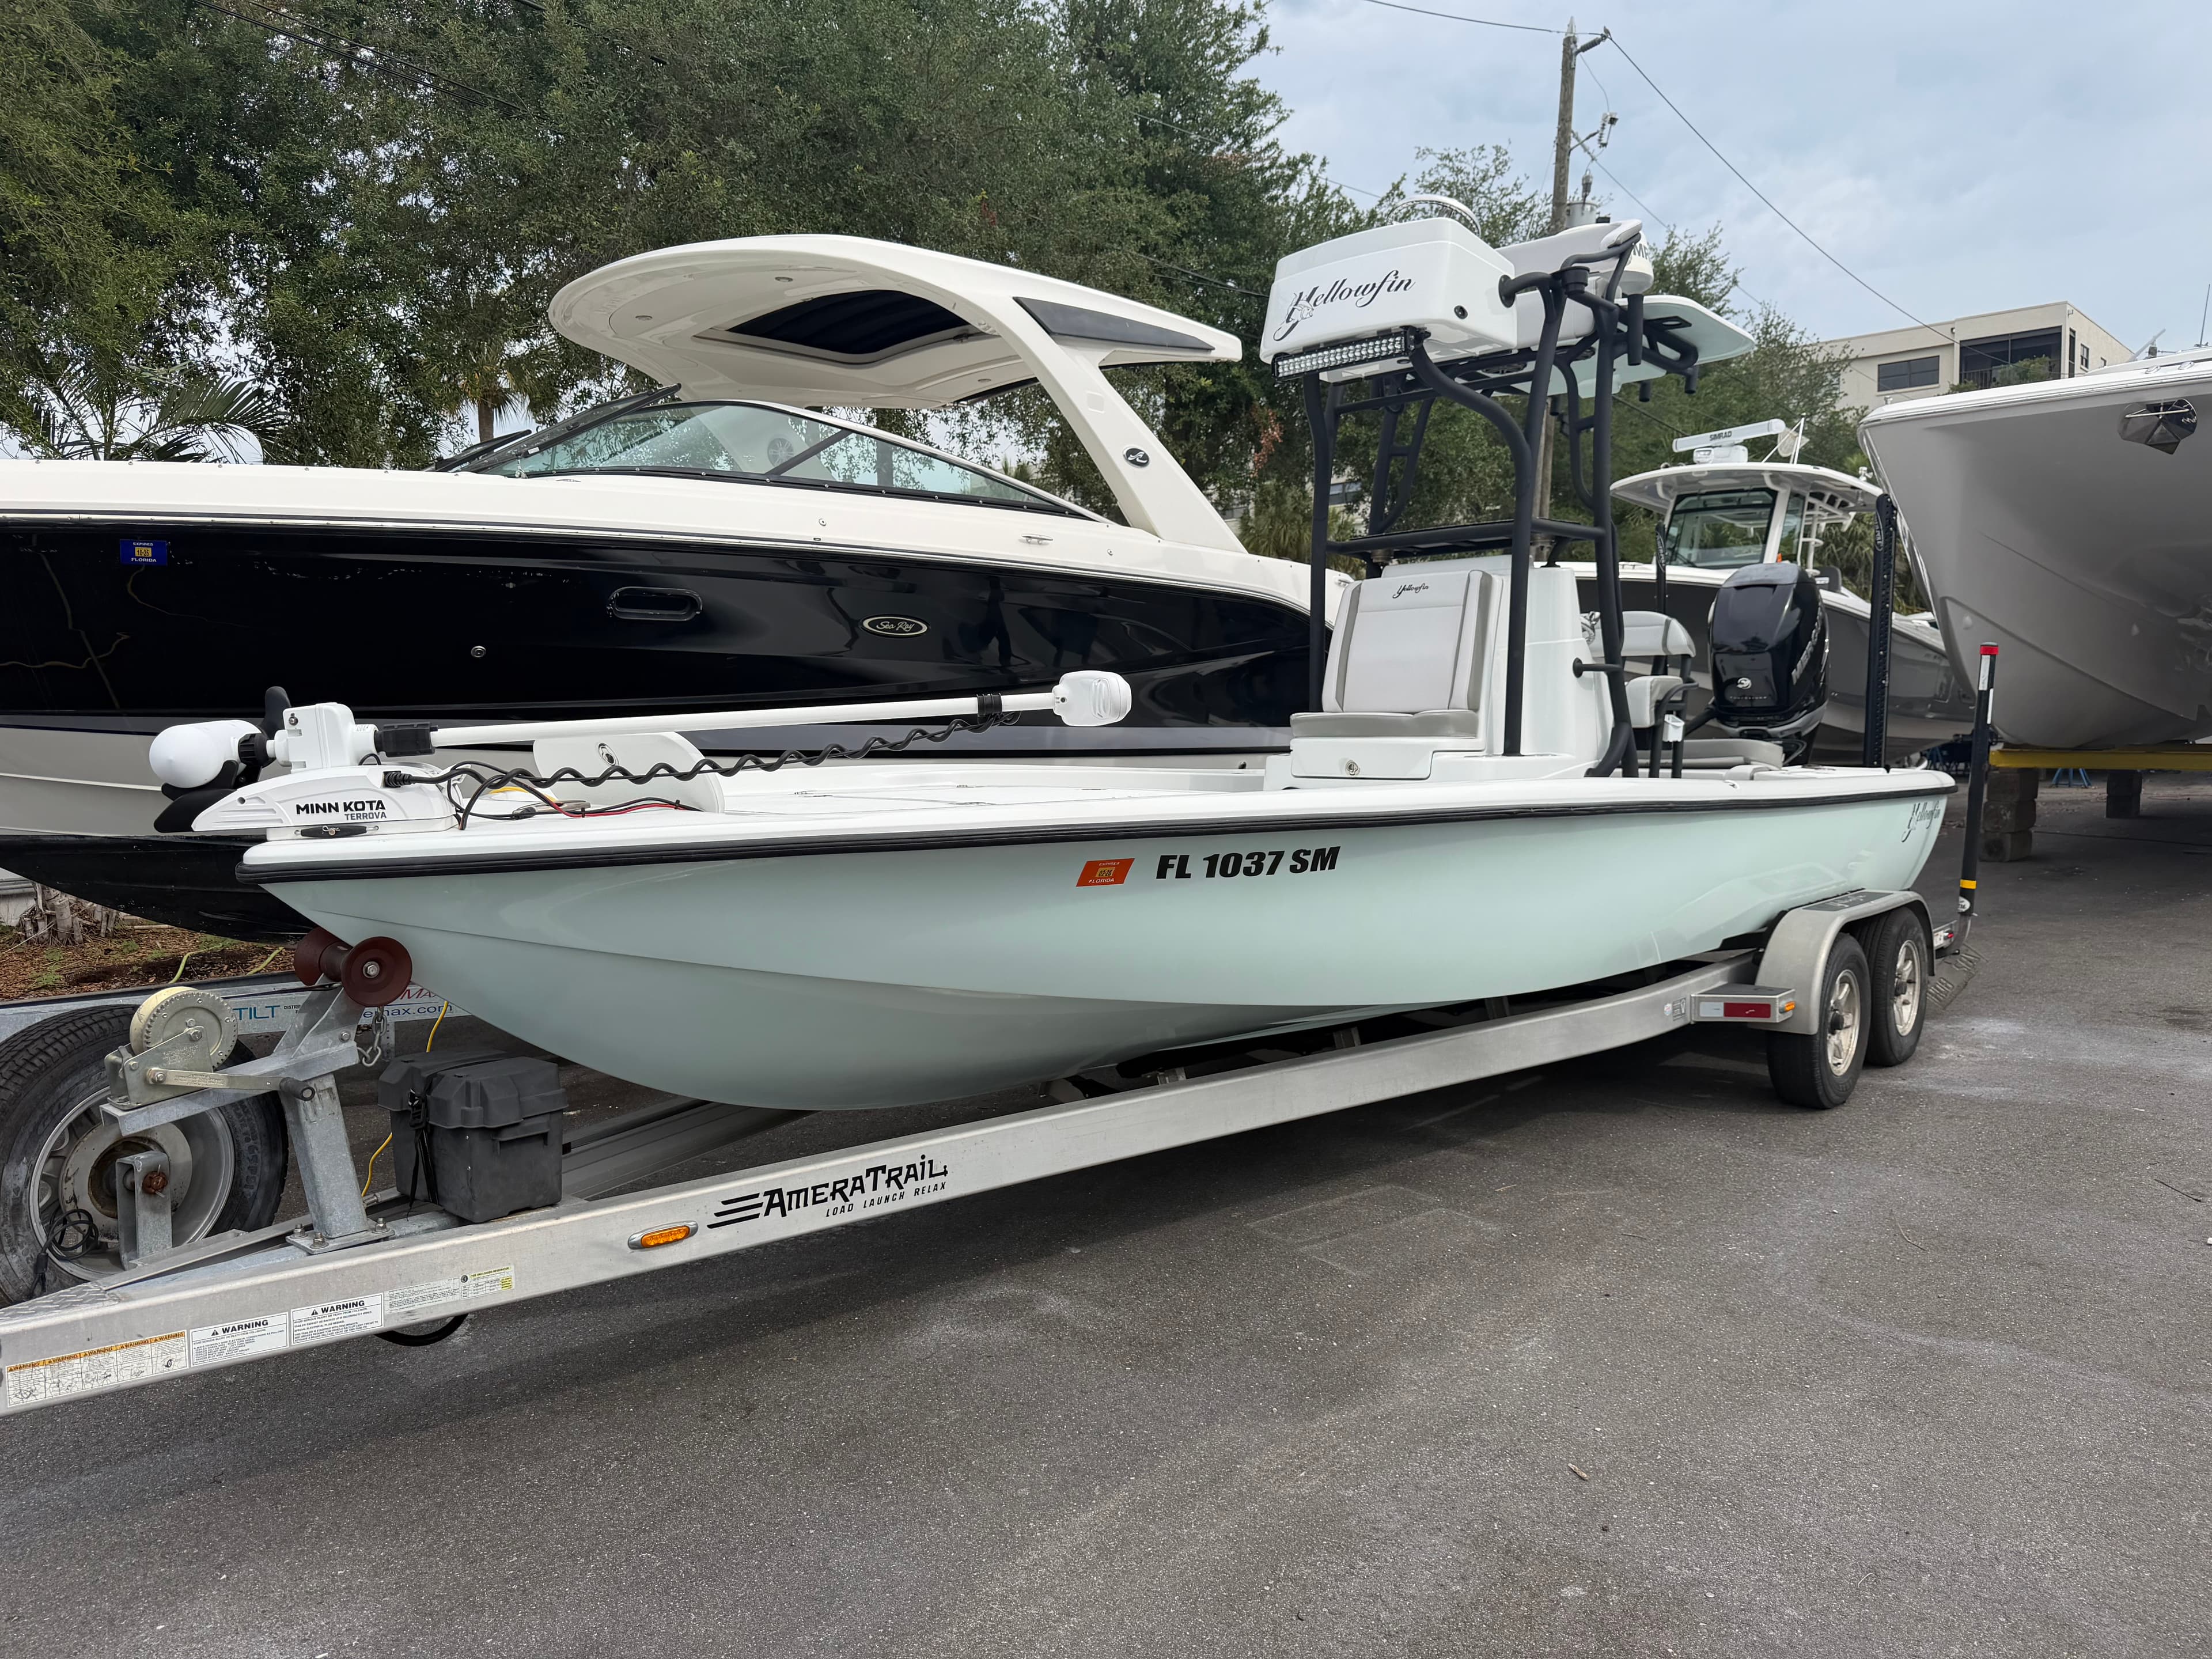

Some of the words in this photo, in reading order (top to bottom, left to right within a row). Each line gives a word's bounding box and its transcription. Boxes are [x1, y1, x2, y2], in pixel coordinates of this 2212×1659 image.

[1273, 270, 1416, 342] Yellowfin
[1392, 583, 1429, 599] Yellowfin
[896, 622, 915, 631] Ray
[296, 802, 339, 815] MINN
[343, 800, 386, 812] KOTA
[344, 812, 387, 820] TERROVA
[1156, 855, 1191, 879] FL
[1203, 850, 1285, 878] 1037
[1289, 846, 1341, 874] SM
[233, 1005, 281, 1020] TILT
[826, 1203, 854, 1218] LOAD
[863, 1191, 905, 1209] LAUNCH
[914, 1181, 947, 1197] RELAX
[321, 1300, 365, 1313] WARNING
[222, 1320, 268, 1334] WARNING
[158, 1332, 183, 1342] WARNING
[124, 1339, 149, 1349] WARNING
[88, 1347, 113, 1356] WARNING
[52, 1354, 78, 1363] WARNING
